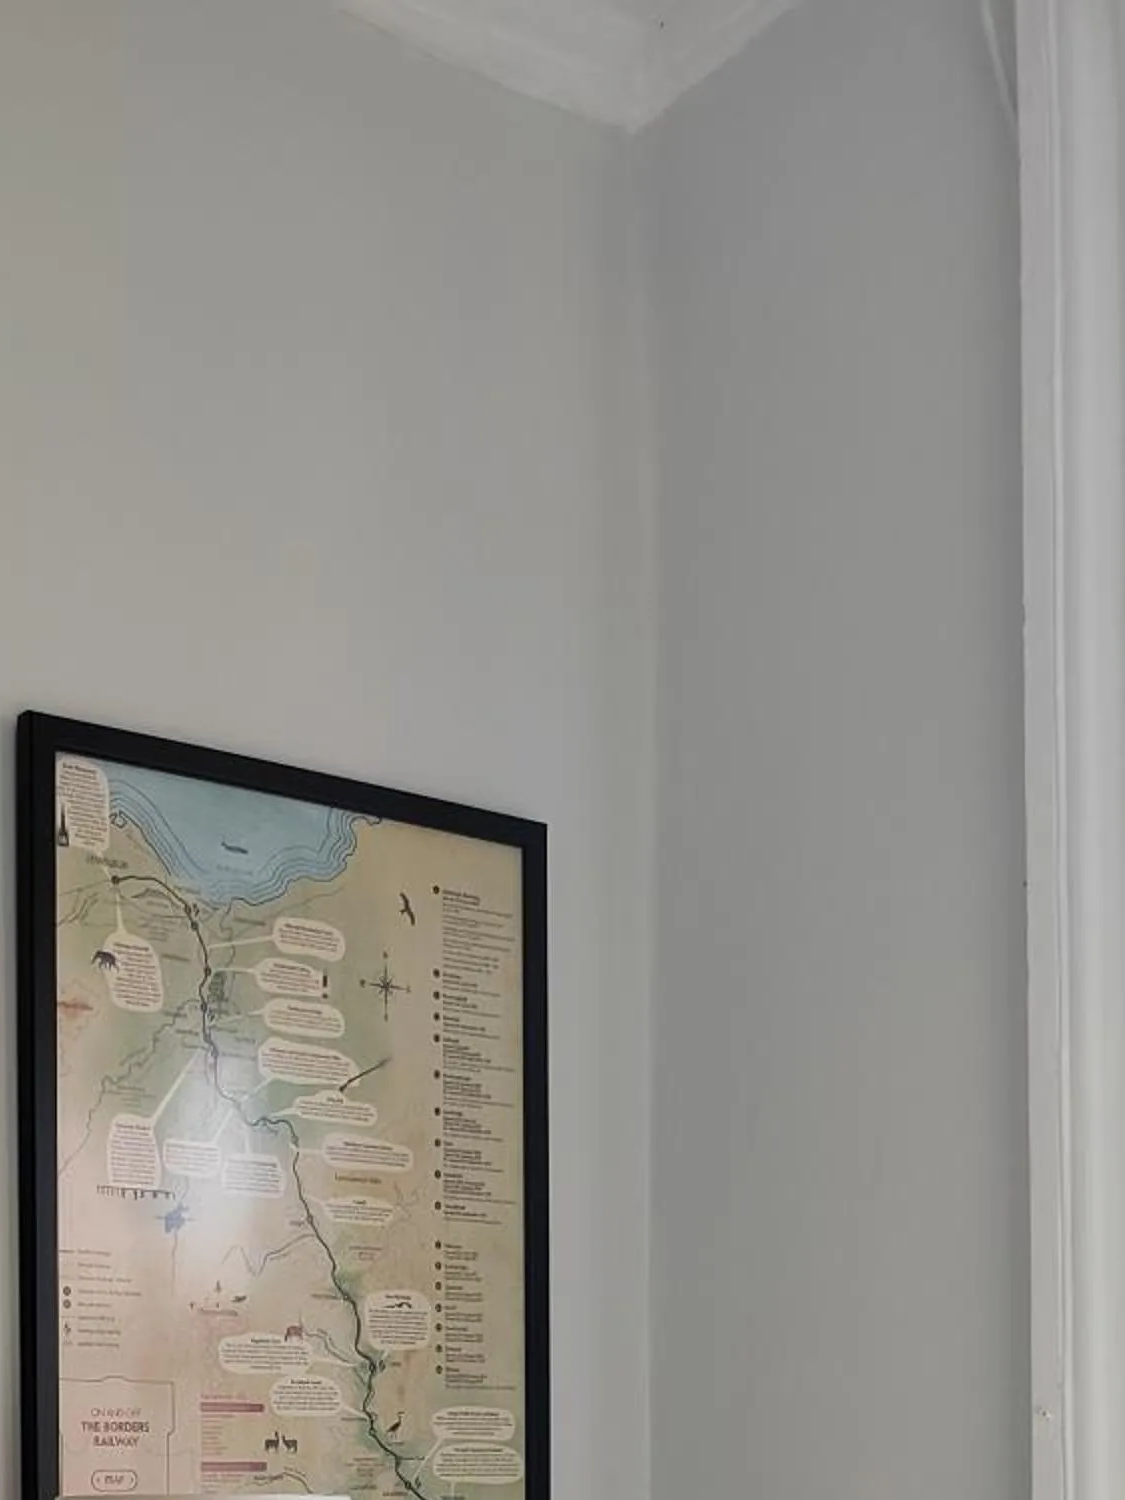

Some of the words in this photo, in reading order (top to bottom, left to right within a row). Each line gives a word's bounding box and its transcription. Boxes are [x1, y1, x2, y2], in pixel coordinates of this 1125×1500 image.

[80, 1420, 100, 1433] THE
[102, 1420, 150, 1433] BORDERS
[92, 1434, 140, 1448] RAILWAY
